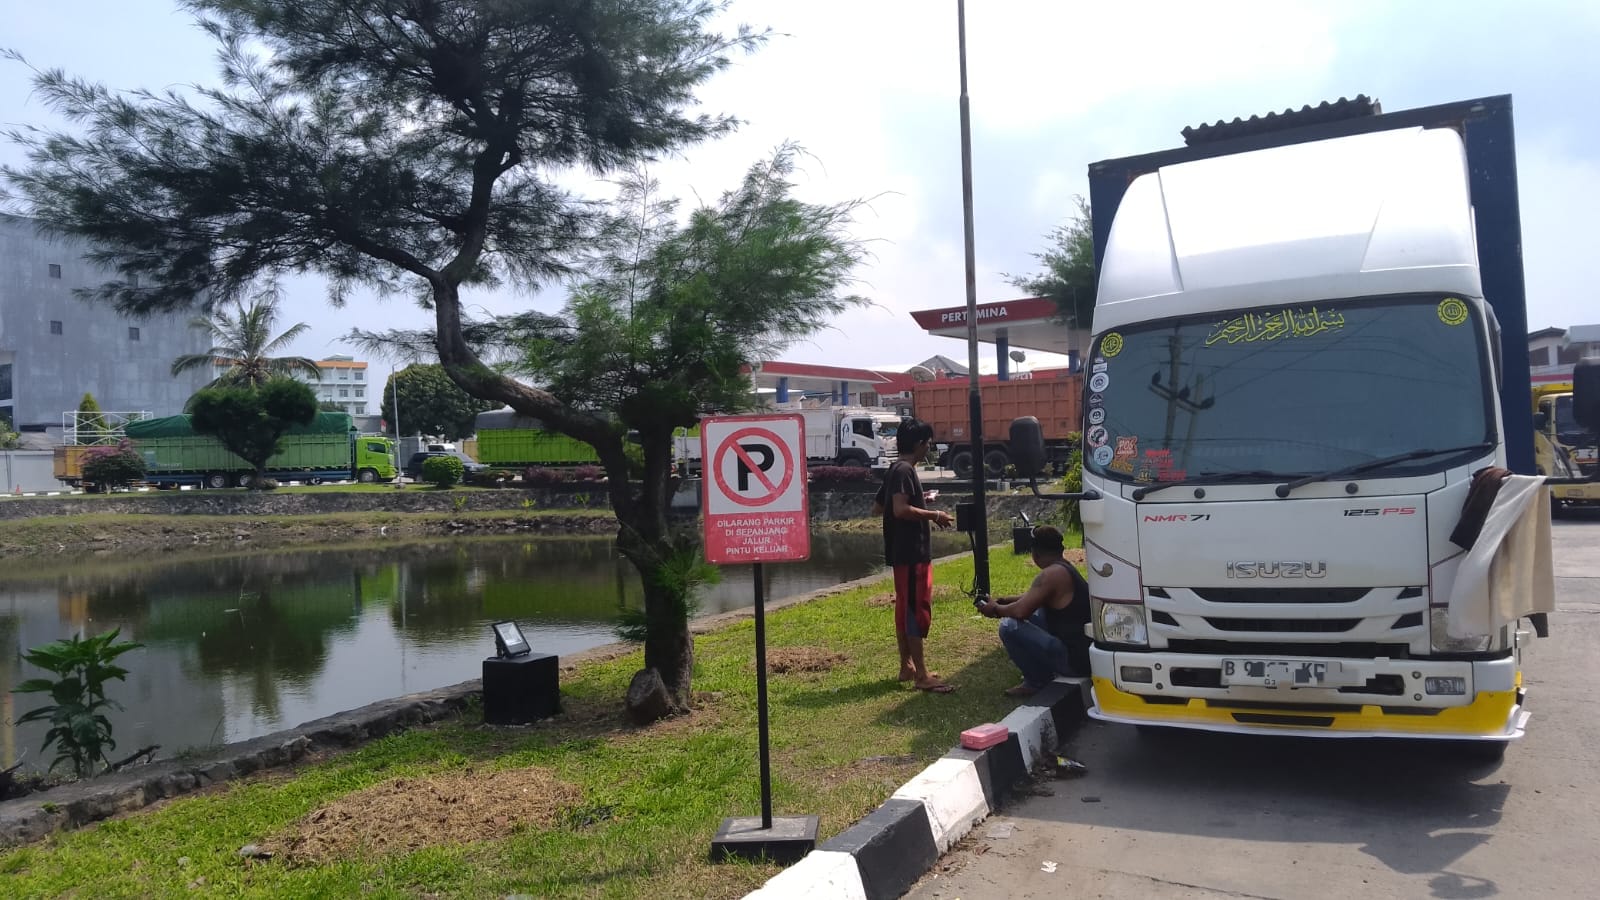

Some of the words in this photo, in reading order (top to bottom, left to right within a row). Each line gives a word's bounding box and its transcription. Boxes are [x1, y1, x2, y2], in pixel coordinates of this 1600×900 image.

[942, 306, 1008, 322] PERTMINA
[737, 443, 775, 491] P
[1343, 508, 1380, 517] 125
[1382, 506, 1416, 516] PS
[717, 519, 760, 528] DILARANG
[763, 517, 794, 526] PARKIR
[1144, 514, 1187, 522] NMR
[1190, 514, 1210, 522] 71
[726, 529, 733, 537] DI
[736, 527, 788, 536] SEPANJANG
[743, 537, 770, 545] JALUR
[754, 545, 788, 554] KELUAR
[1226, 560, 1327, 579] ISUZU
